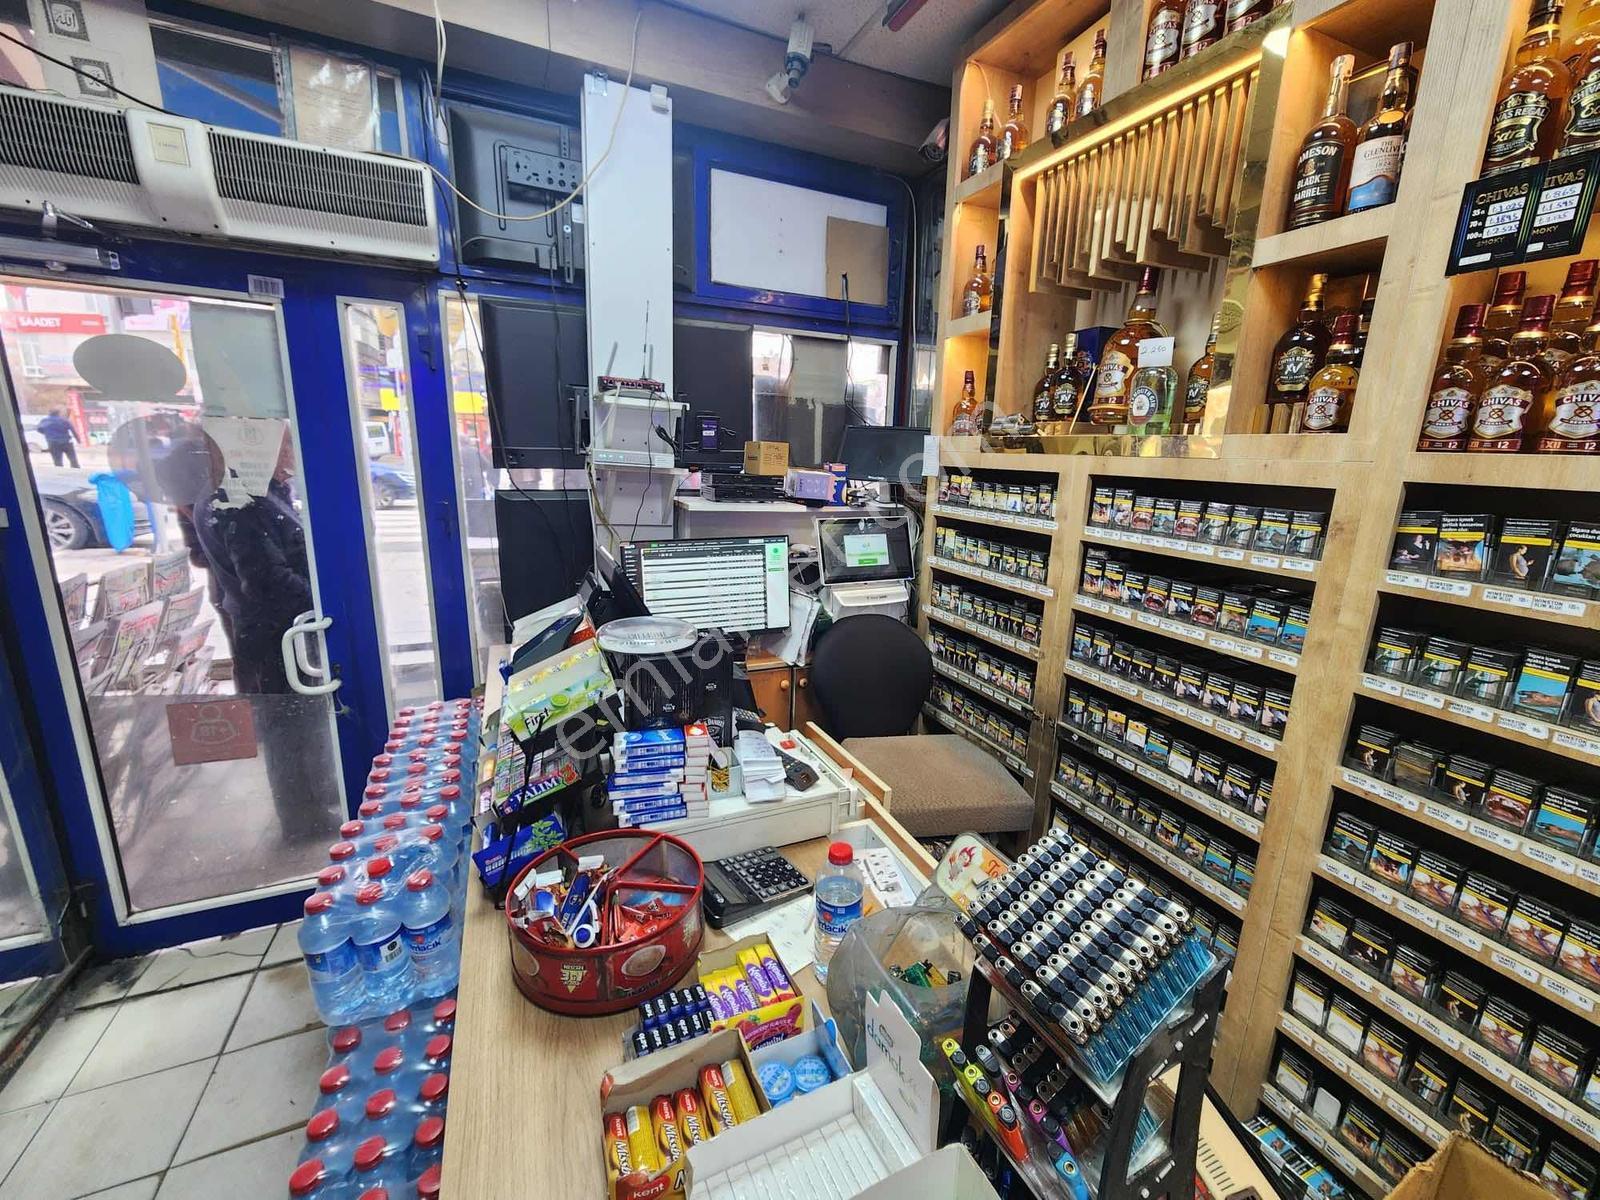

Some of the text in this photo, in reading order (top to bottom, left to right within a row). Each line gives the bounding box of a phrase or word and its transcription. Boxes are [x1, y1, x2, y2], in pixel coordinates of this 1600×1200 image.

[1516, 108, 1546, 118] REGAL
[1298, 145, 1338, 164] AMESON
[1297, 175, 1321, 189] BLACK
[1476, 183, 1529, 205] CHIVAS
[1532, 225, 1559, 235] MOKY
[19, 317, 61, 327] SAADET
[1309, 396, 1339, 404] CHIVAS
[1430, 400, 1470, 409] CHIVAS
[1482, 397, 1522, 407] CHIVAS
[1447, 441, 1458, 449] 12
[1497, 441, 1509, 449] 12
[1545, 441, 1597, 450] XII 12
[525, 707, 550, 728] First
[714, 1090, 735, 1130] Missbo
[663, 1123, 680, 1162] Missbo
[632, 1182, 665, 1200] kent
